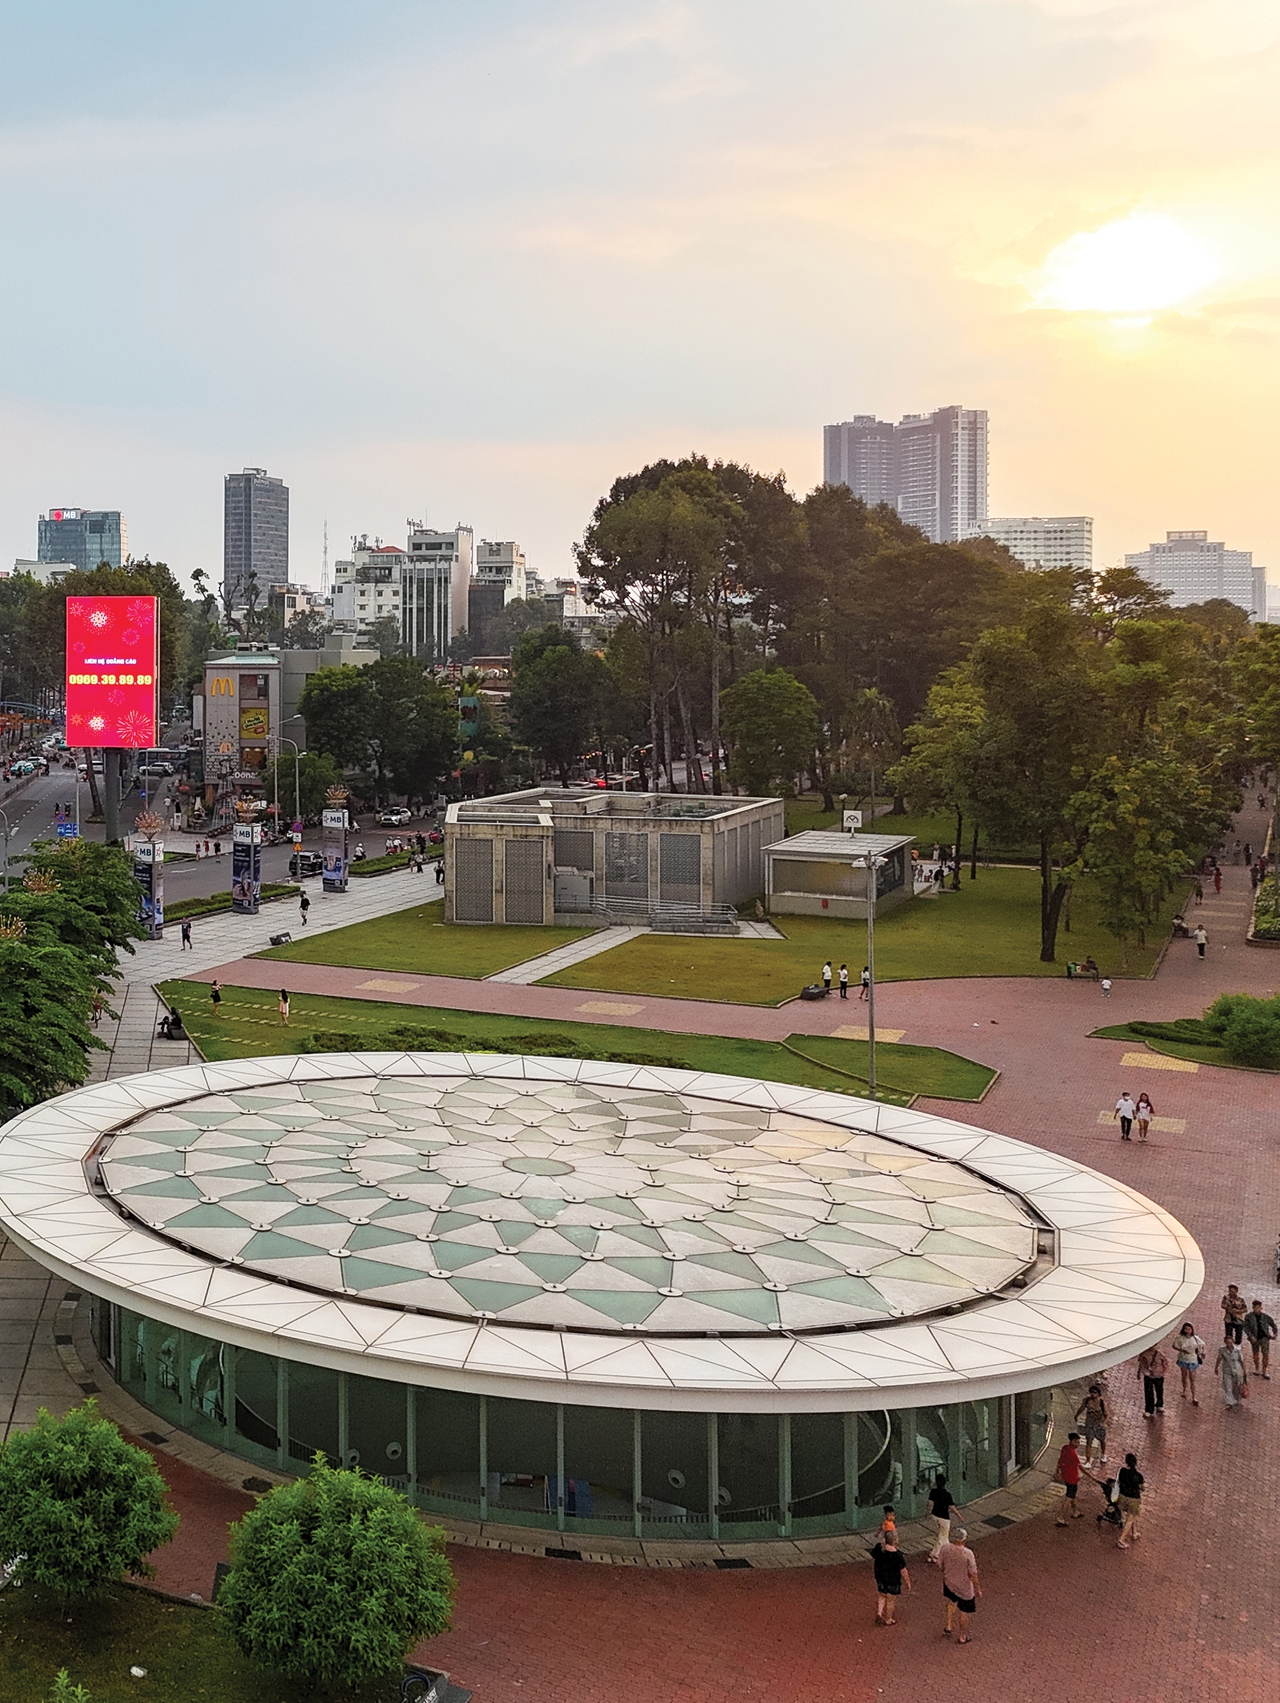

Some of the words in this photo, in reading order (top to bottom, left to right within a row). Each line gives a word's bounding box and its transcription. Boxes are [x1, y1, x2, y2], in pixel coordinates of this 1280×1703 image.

[63, 510, 77, 520] MB
[329, 816, 342, 824] MB
[238, 830, 251, 838] MB
[139, 848, 152, 857] MB
